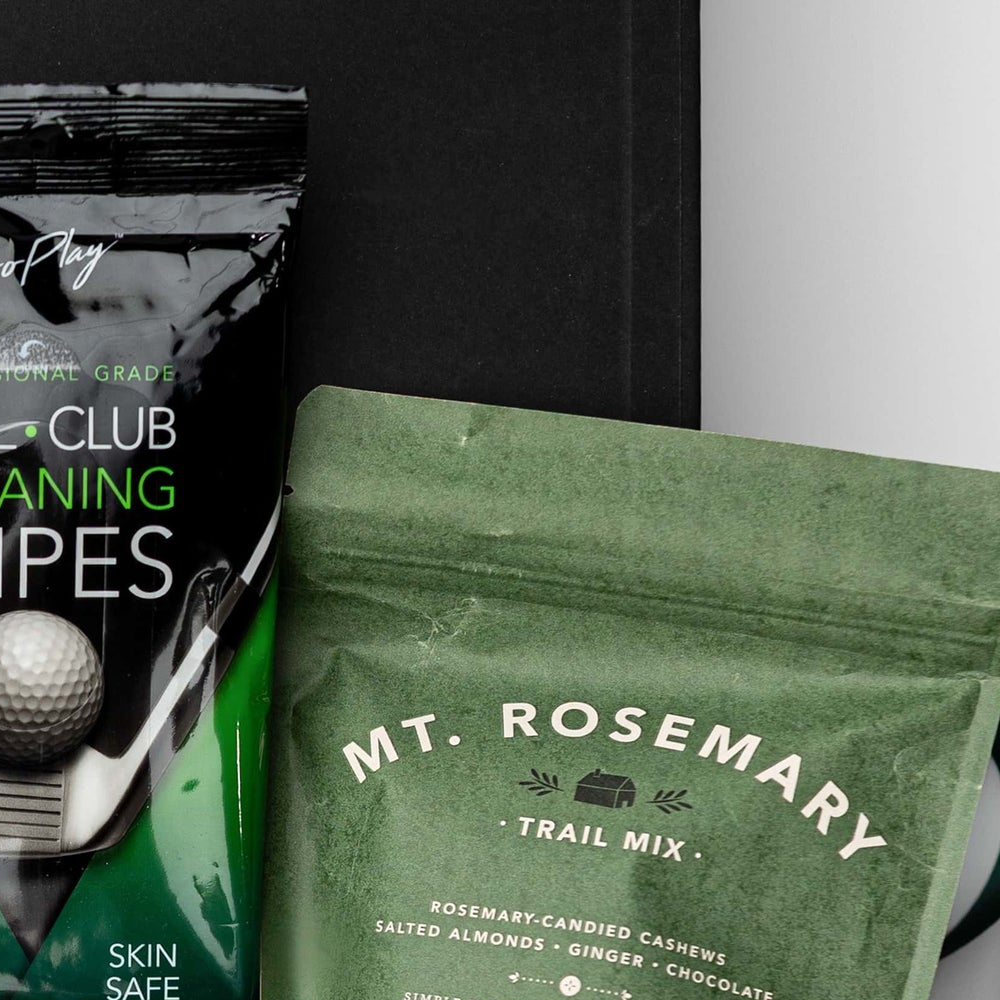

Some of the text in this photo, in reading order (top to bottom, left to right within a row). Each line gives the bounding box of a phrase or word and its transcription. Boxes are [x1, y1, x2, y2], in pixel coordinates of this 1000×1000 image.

[94, 364, 175, 382] GRADE
[48, 405, 177, 451] CLUB
[341, 701, 888, 861] MT. ROSEMARY
[518, 816, 686, 862] TRAIL MIX
[109, 943, 177, 968] SKIN
[375, 920, 441, 938] SALTED
[448, 927, 545, 951] ALMONDS
[568, 943, 645, 968] GINGER
[639, 931, 727, 966] CASHEWS
